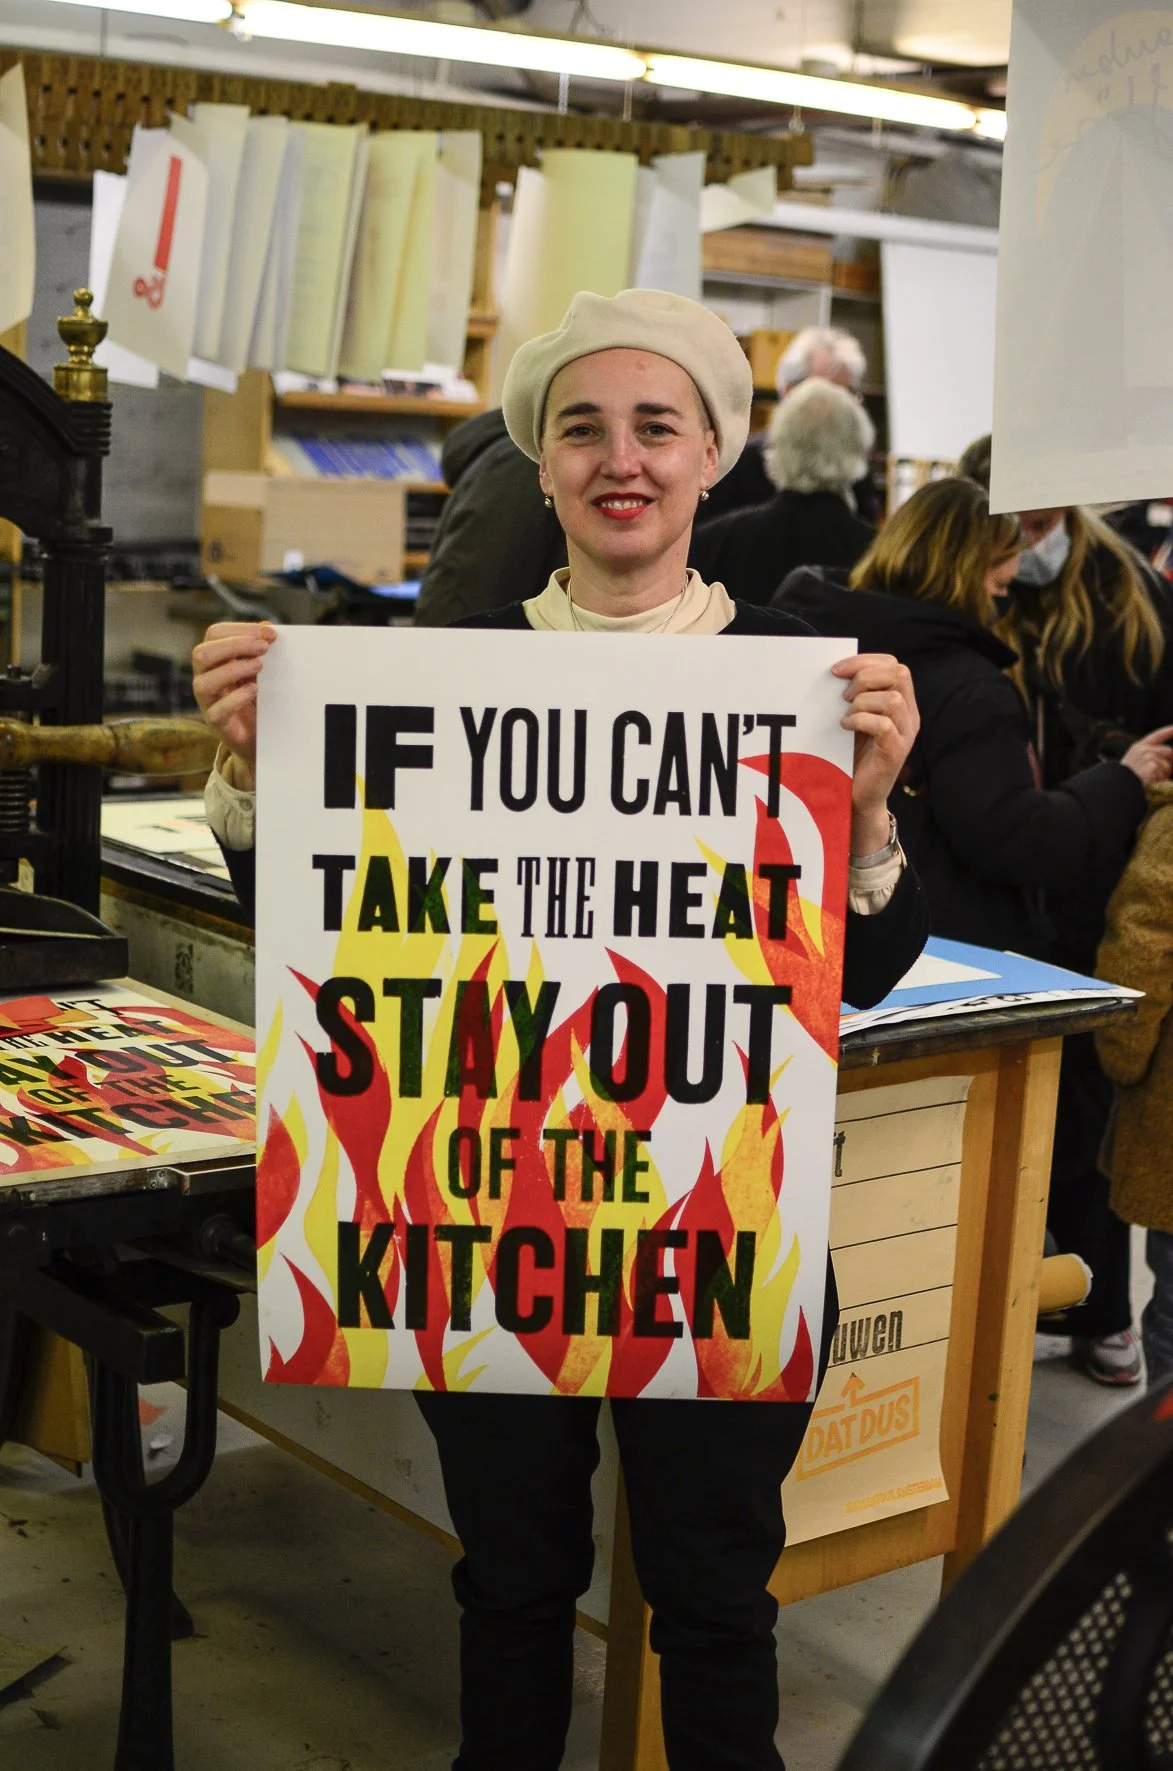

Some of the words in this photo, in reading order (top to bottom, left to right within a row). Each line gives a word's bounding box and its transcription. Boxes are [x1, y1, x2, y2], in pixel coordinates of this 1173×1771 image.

[324, 704, 435, 810] IF
[459, 706, 588, 813] YOU
[610, 710, 797, 818] CAN'T
[312, 854, 499, 935] TAKE
[517, 857, 596, 939] THE
[613, 860, 802, 940] HEAT
[0, 1034, 50, 1050] HE
[41, 1020, 177, 1045] HEAT
[0, 1055, 78, 1086] AY
[74, 1039, 239, 1074] OUT
[315, 976, 562, 1101] STAY
[589, 982, 793, 1105] OUT
[0, 1088, 256, 1146] KITCHE
[28, 1084, 92, 1105] OF
[93, 1073, 202, 1097] THE
[447, 1126, 521, 1200] OF
[542, 1128, 653, 1204] THE
[336, 1220, 757, 1340] KITCHEN
